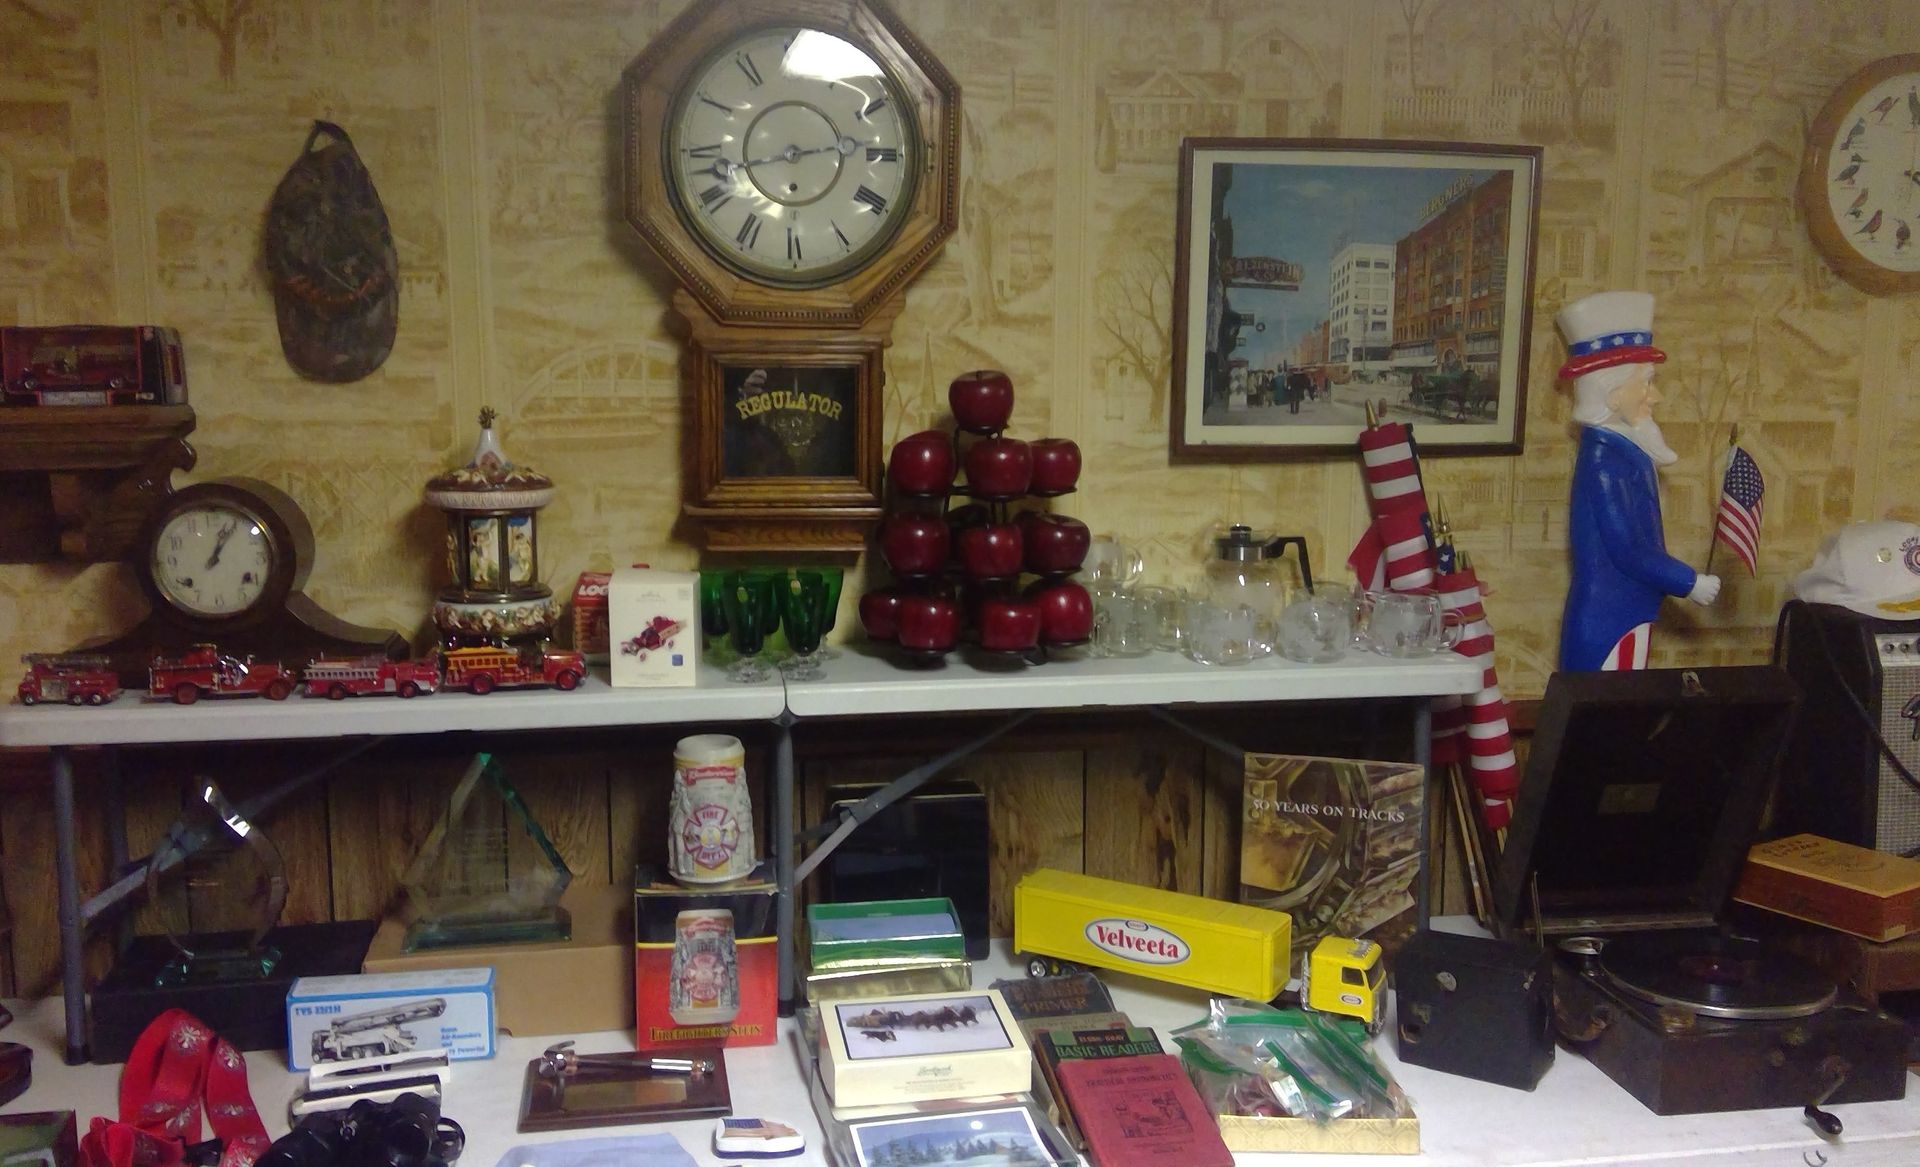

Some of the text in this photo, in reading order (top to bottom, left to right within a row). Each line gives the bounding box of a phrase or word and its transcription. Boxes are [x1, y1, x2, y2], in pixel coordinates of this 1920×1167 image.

[735, 389, 843, 421] REGULATOR
[1273, 801, 1320, 816] YEARS
[1323, 804, 1345, 818] ON
[1348, 807, 1406, 824] TRACKS
[1095, 923, 1179, 959] Velveeta
[1054, 1042, 1160, 1059] BASIC READERS
